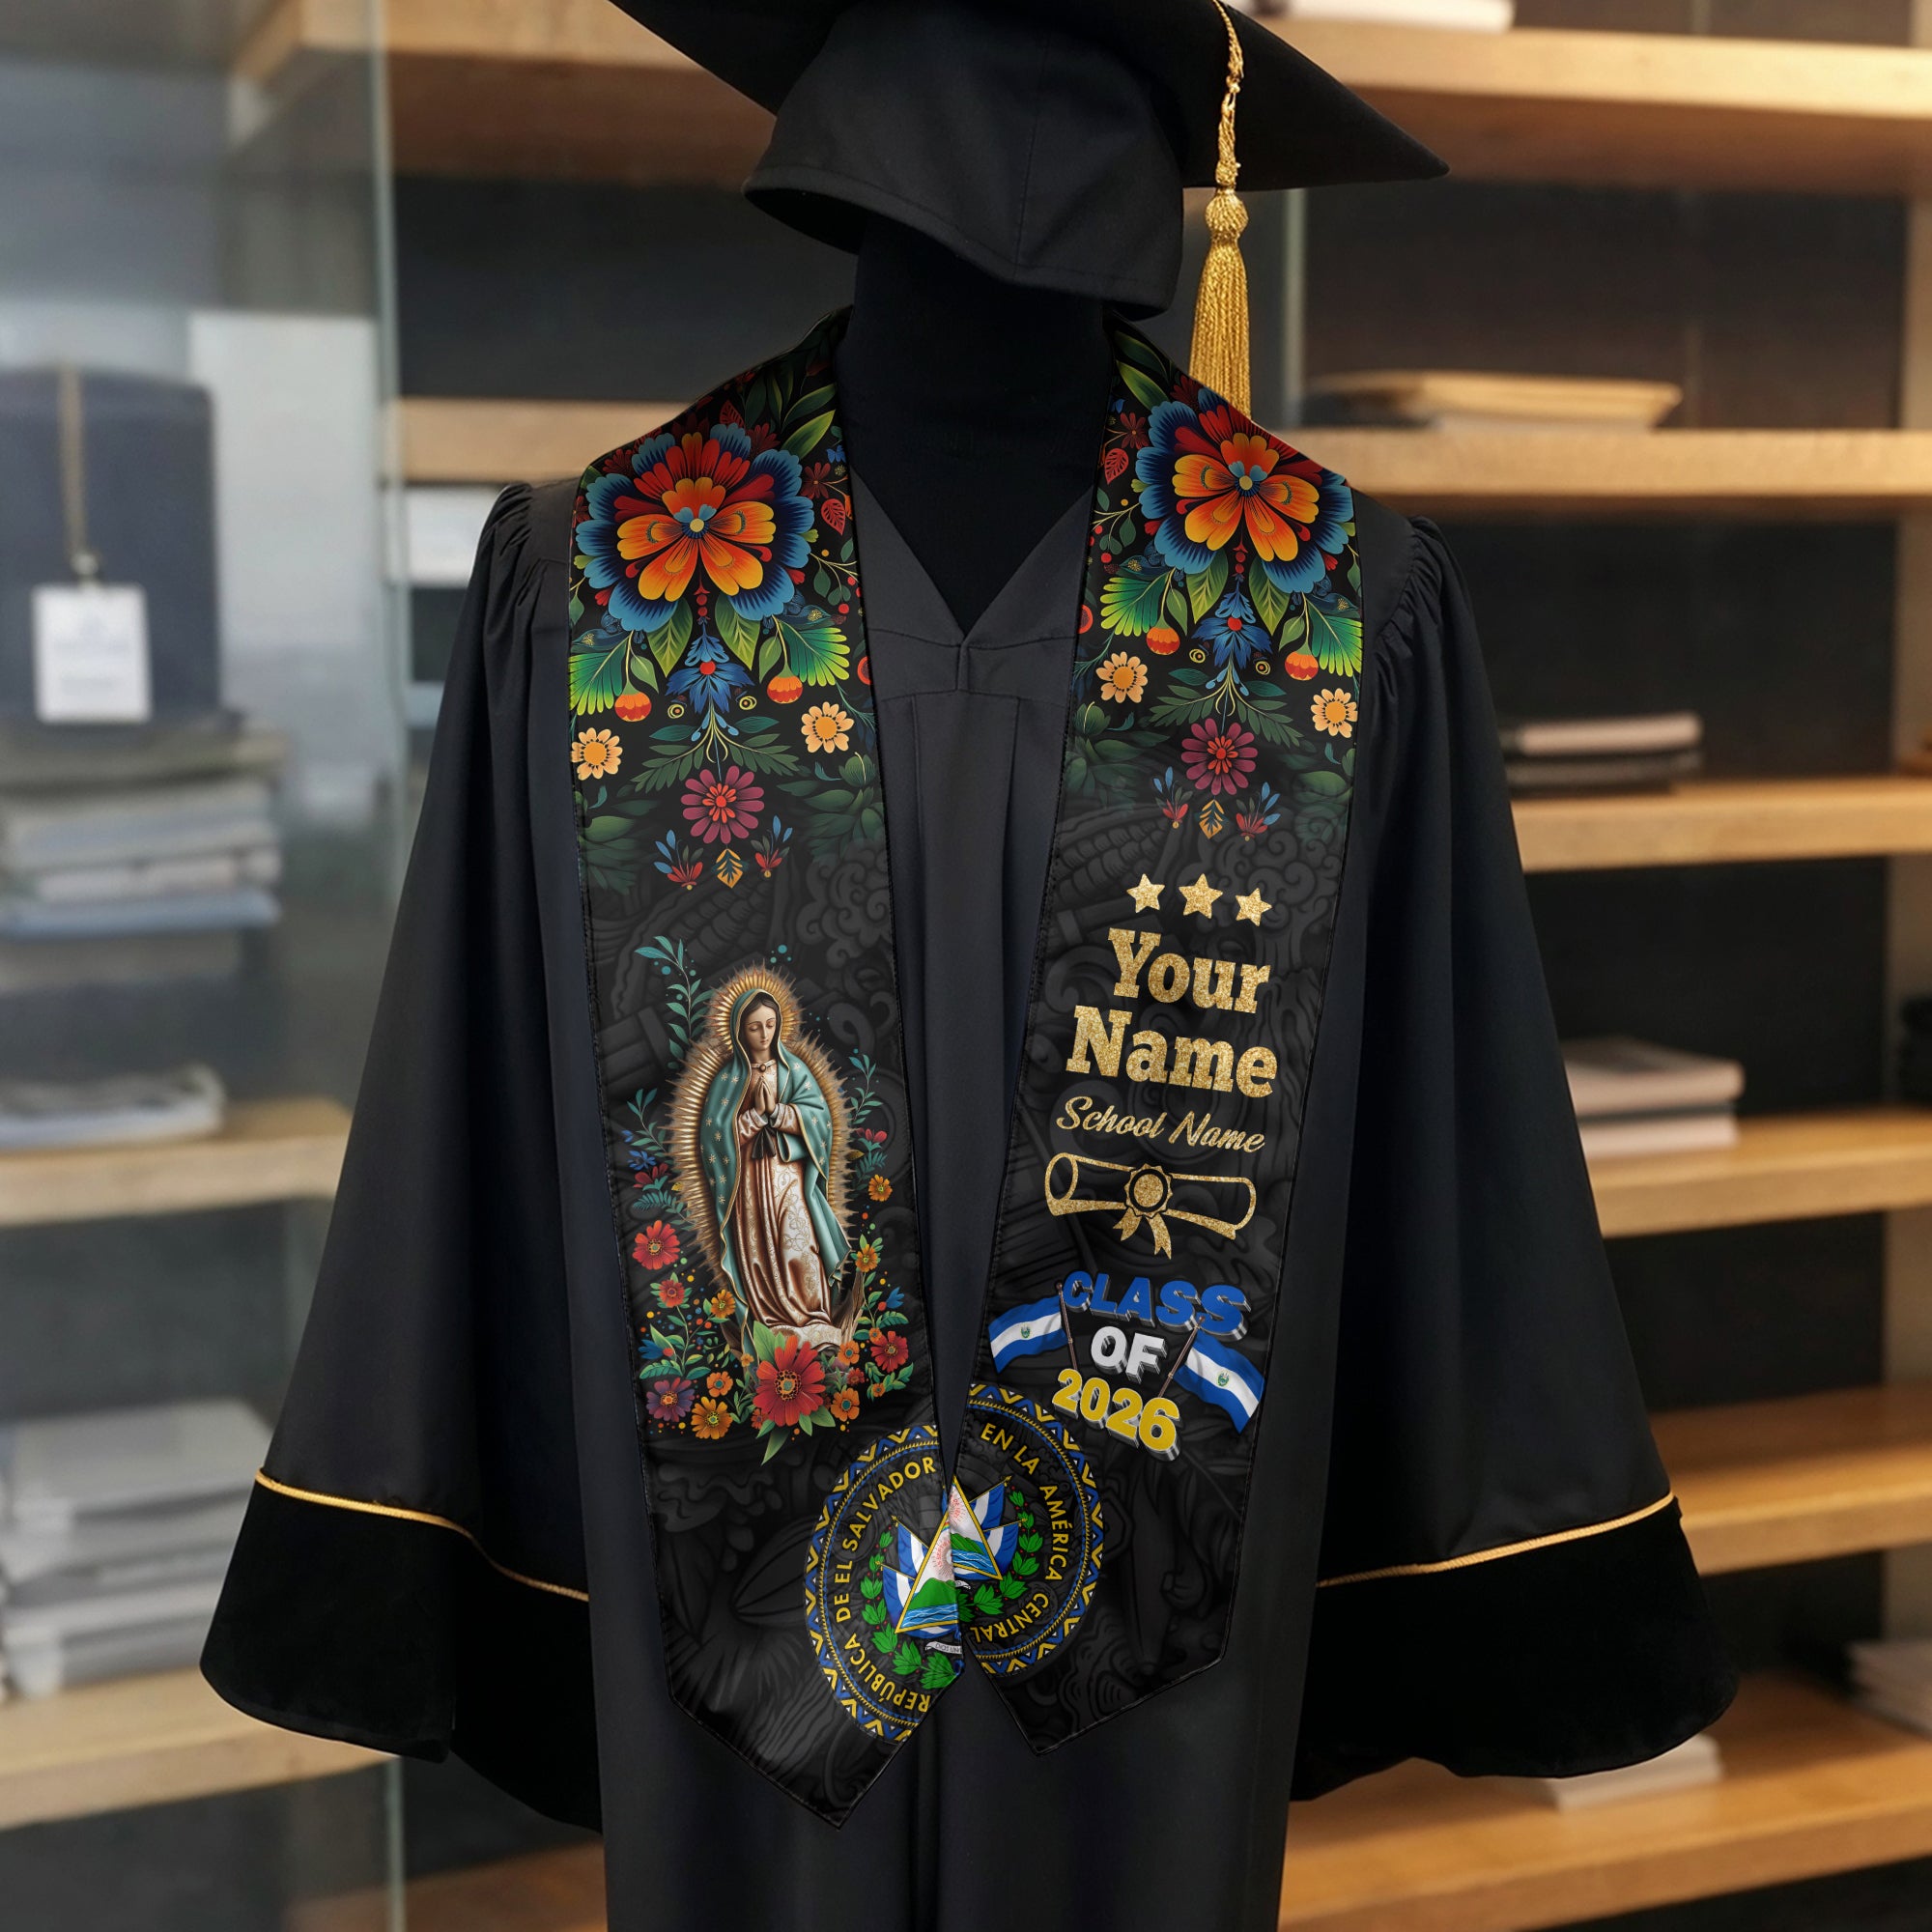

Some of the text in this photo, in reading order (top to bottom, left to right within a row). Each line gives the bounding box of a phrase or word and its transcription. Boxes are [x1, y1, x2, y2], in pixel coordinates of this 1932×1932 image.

[1108, 927, 1271, 1014] Your
[1065, 1005, 1278, 1098] Name
[1056, 1095, 1265, 1153] School Name
[1063, 1270, 1251, 1341] CLASS
[1091, 1325, 1167, 1384] OF
[1052, 1368, 1180, 1462] 2026
[970, 1422, 1073, 1642] EN LA AMÉRICA CENTRAL
[834, 1456, 937, 1713] REPÚBLICA DE EL SALVADOR
